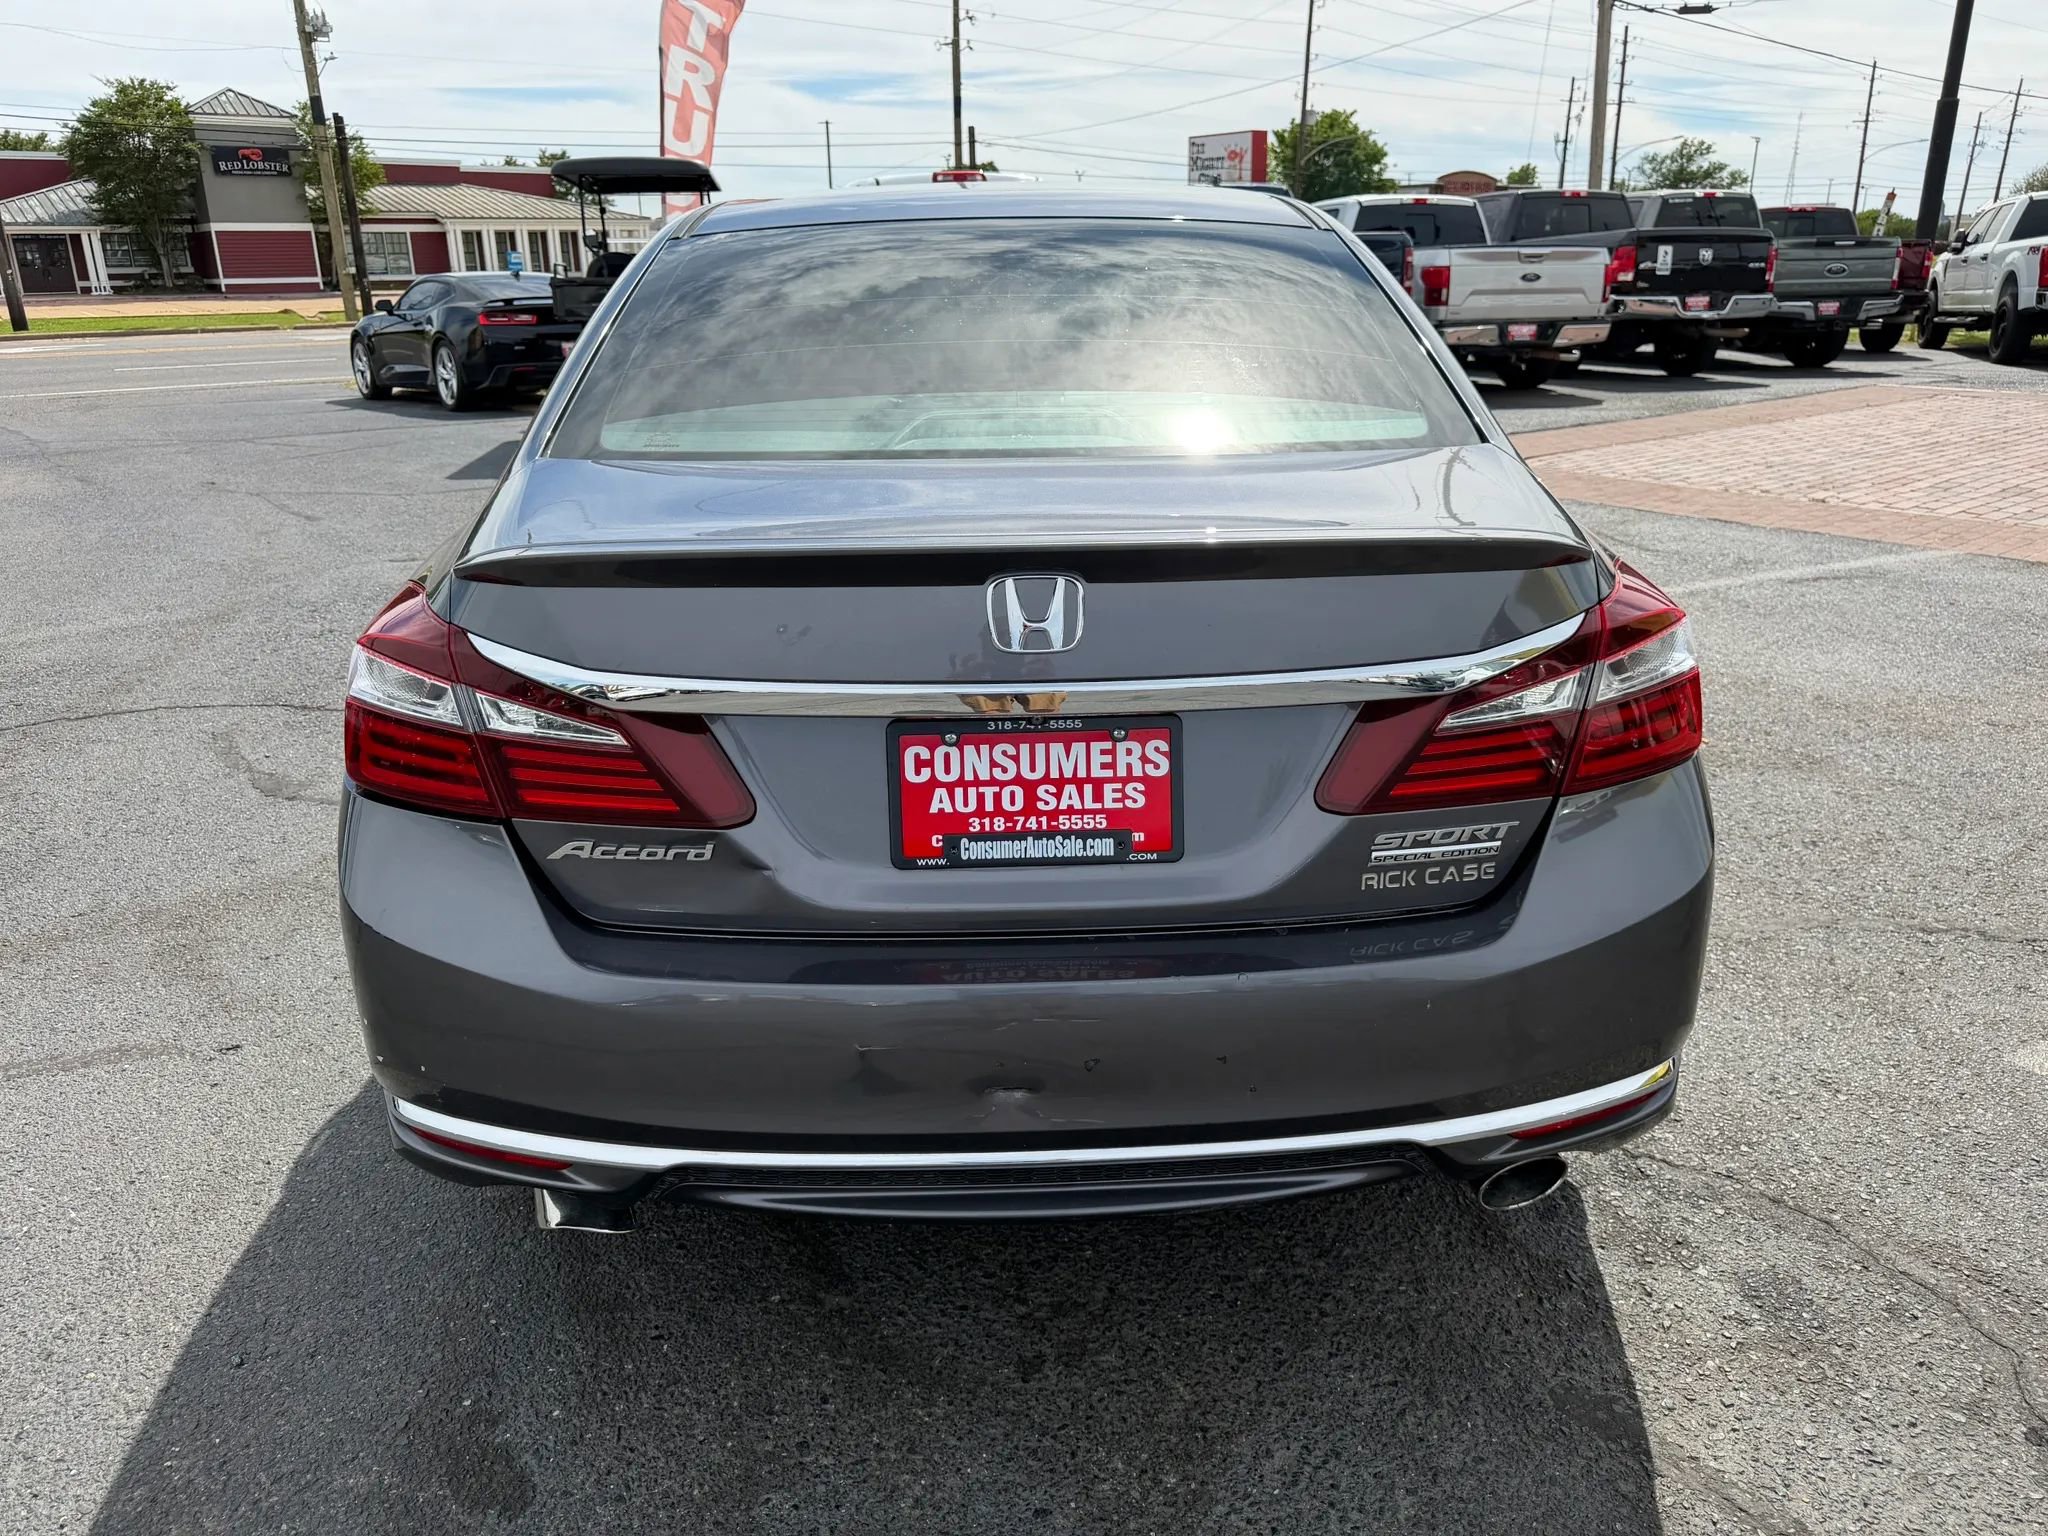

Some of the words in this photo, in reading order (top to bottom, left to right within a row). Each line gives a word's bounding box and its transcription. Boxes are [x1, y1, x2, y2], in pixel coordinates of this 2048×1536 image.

[664, 0, 726, 219] TRU
[218, 161, 242, 172] RED
[243, 160, 290, 173] LOBSTER
[904, 739, 1170, 784] CONSUMERS
[929, 785, 1025, 814] AUTO
[1036, 782, 1146, 811] SALES
[968, 814, 1107, 832] 318-741-5555
[1370, 821, 1521, 851] SPORT
[546, 838, 716, 862] Accord
[960, 835, 1114, 861] ConsumerAutoSale.com
[1372, 852, 1436, 864] SPECIAL
[1441, 846, 1500, 859] EDITION
[1361, 870, 1417, 891] RICK
[1424, 862, 1497, 885] CASE
